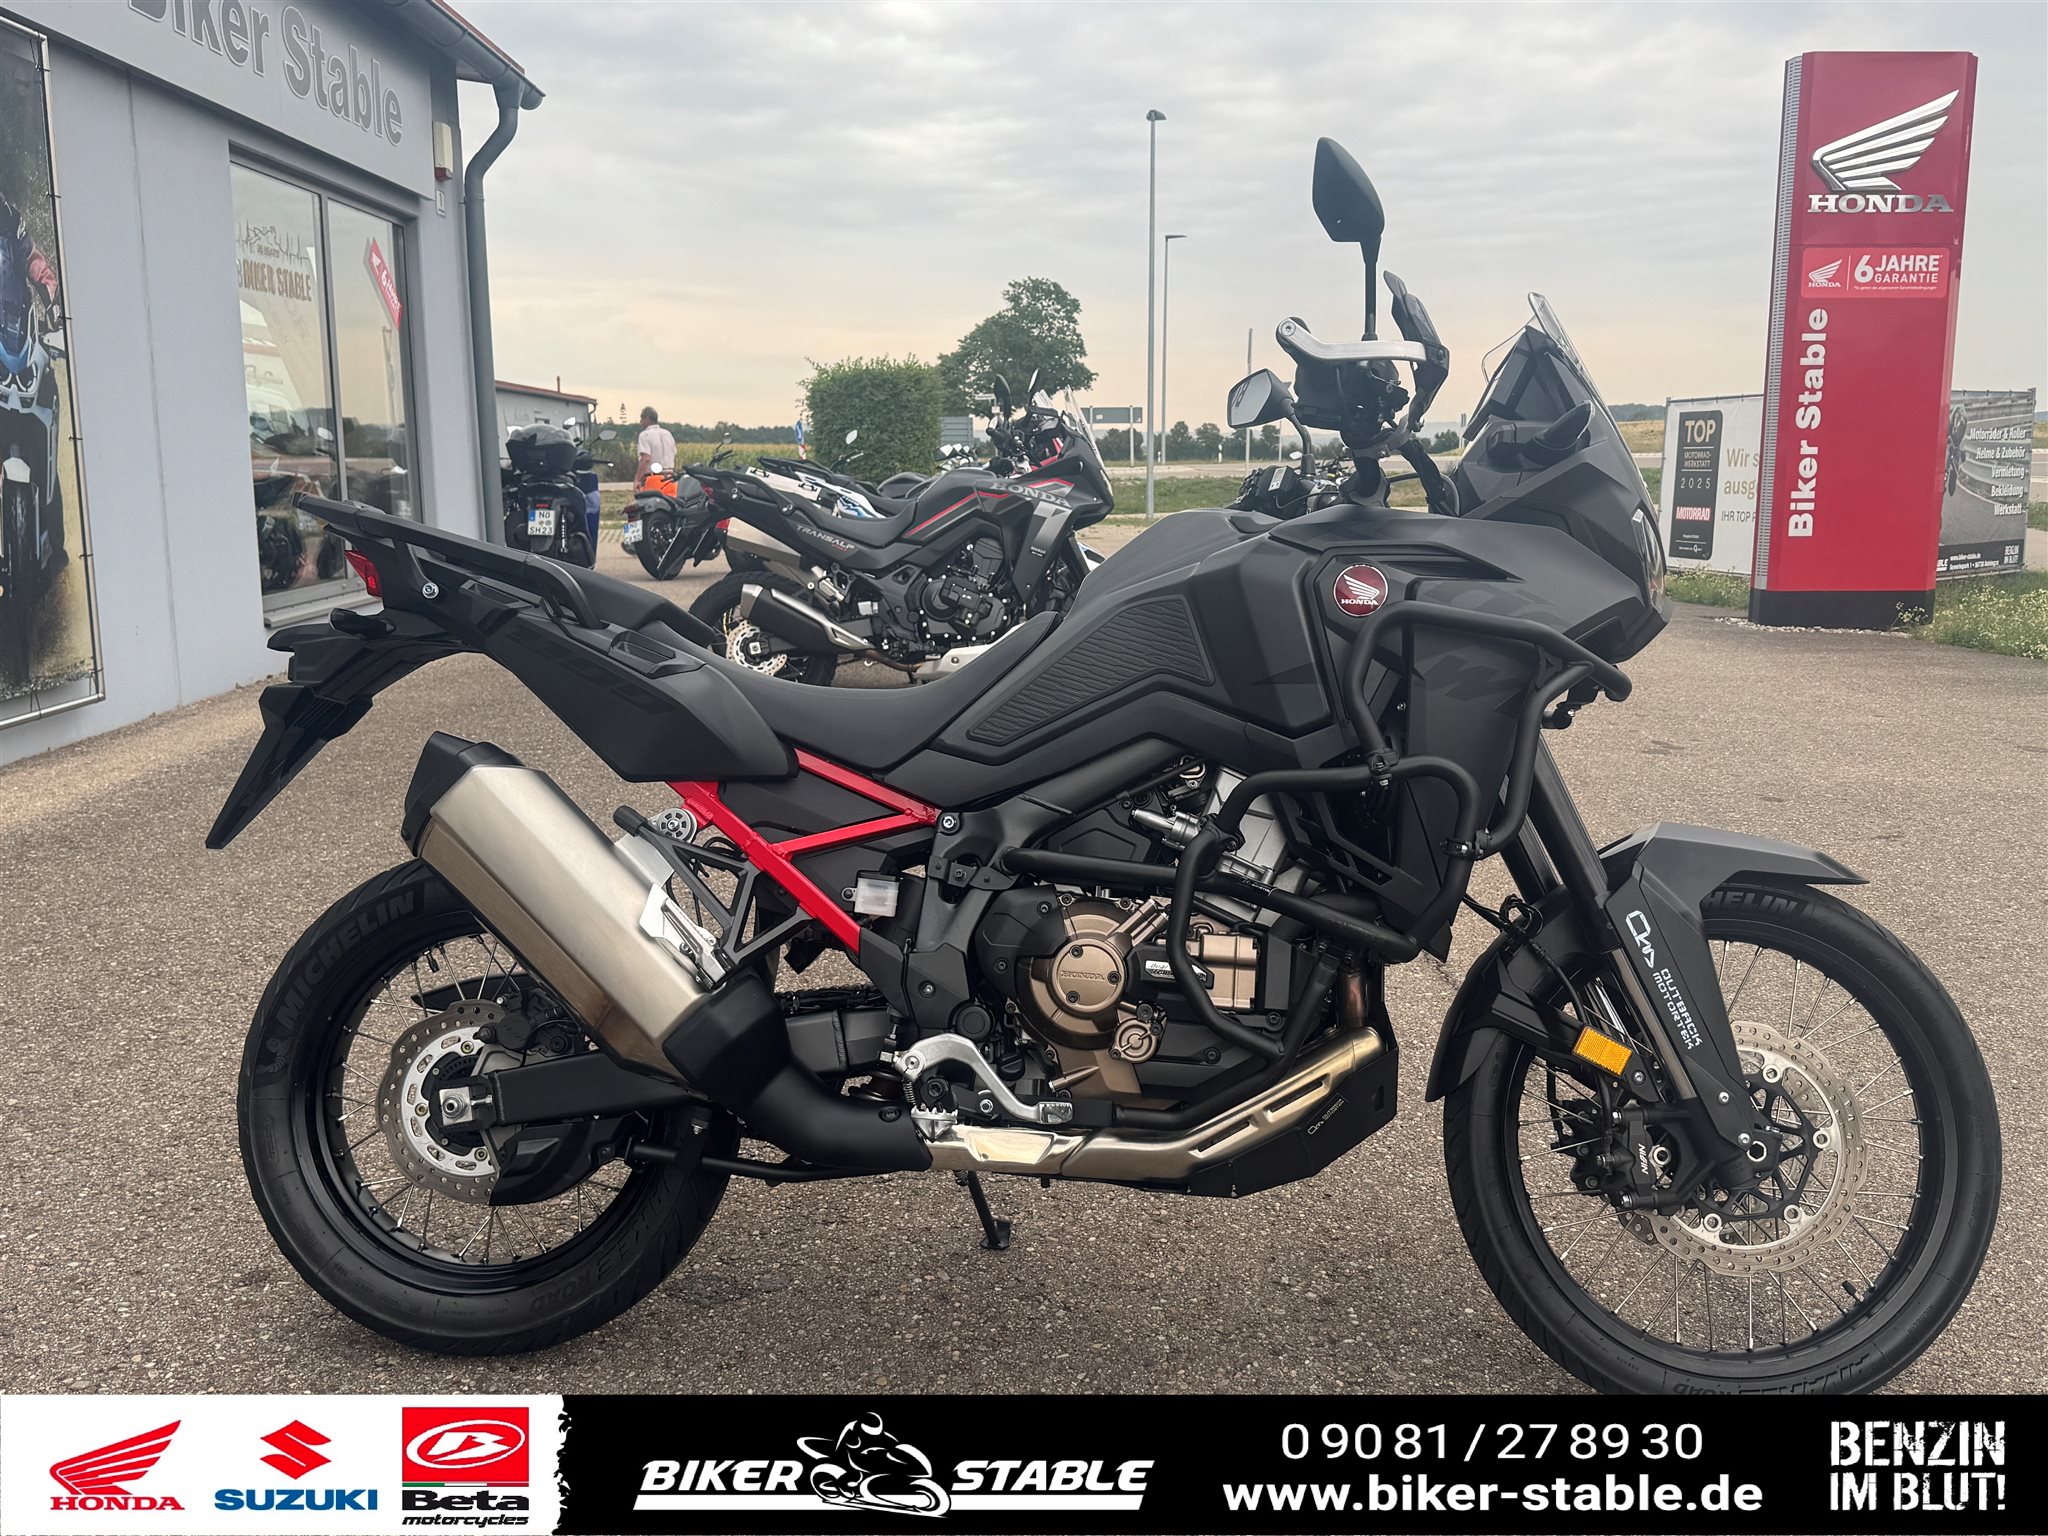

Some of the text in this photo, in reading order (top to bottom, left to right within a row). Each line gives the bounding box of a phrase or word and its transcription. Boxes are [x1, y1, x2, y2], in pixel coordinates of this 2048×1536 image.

[281, 5, 403, 146] Stable
[1807, 193, 1954, 213] HONDA
[1854, 255, 1874, 283] 6
[1874, 273, 1939, 283] GARANTIE
[1684, 419, 1716, 443] TOP
[1787, 308, 1829, 537] Biker Stable
[1726, 448, 1750, 468] Wir
[1991, 466, 2025, 479] Vermietung
[1680, 477, 1711, 489] 2025
[1991, 485, 2024, 498] Bekleidung
[990, 482, 1072, 508] HONDA
[1676, 506, 1711, 521] MOTORRAD
[1721, 510, 1735, 522] IHR
[1736, 511, 1751, 523] TOP
[796, 524, 855, 549] TRANSALP
[1340, 598, 1379, 606] HONDA
[275, 889, 416, 1031] MICHELIN
[1061, 970, 1105, 981] HONDA
[1652, 972, 1695, 1050] MOTORTEK
[1660, 968, 1703, 1047] OUTBACK
